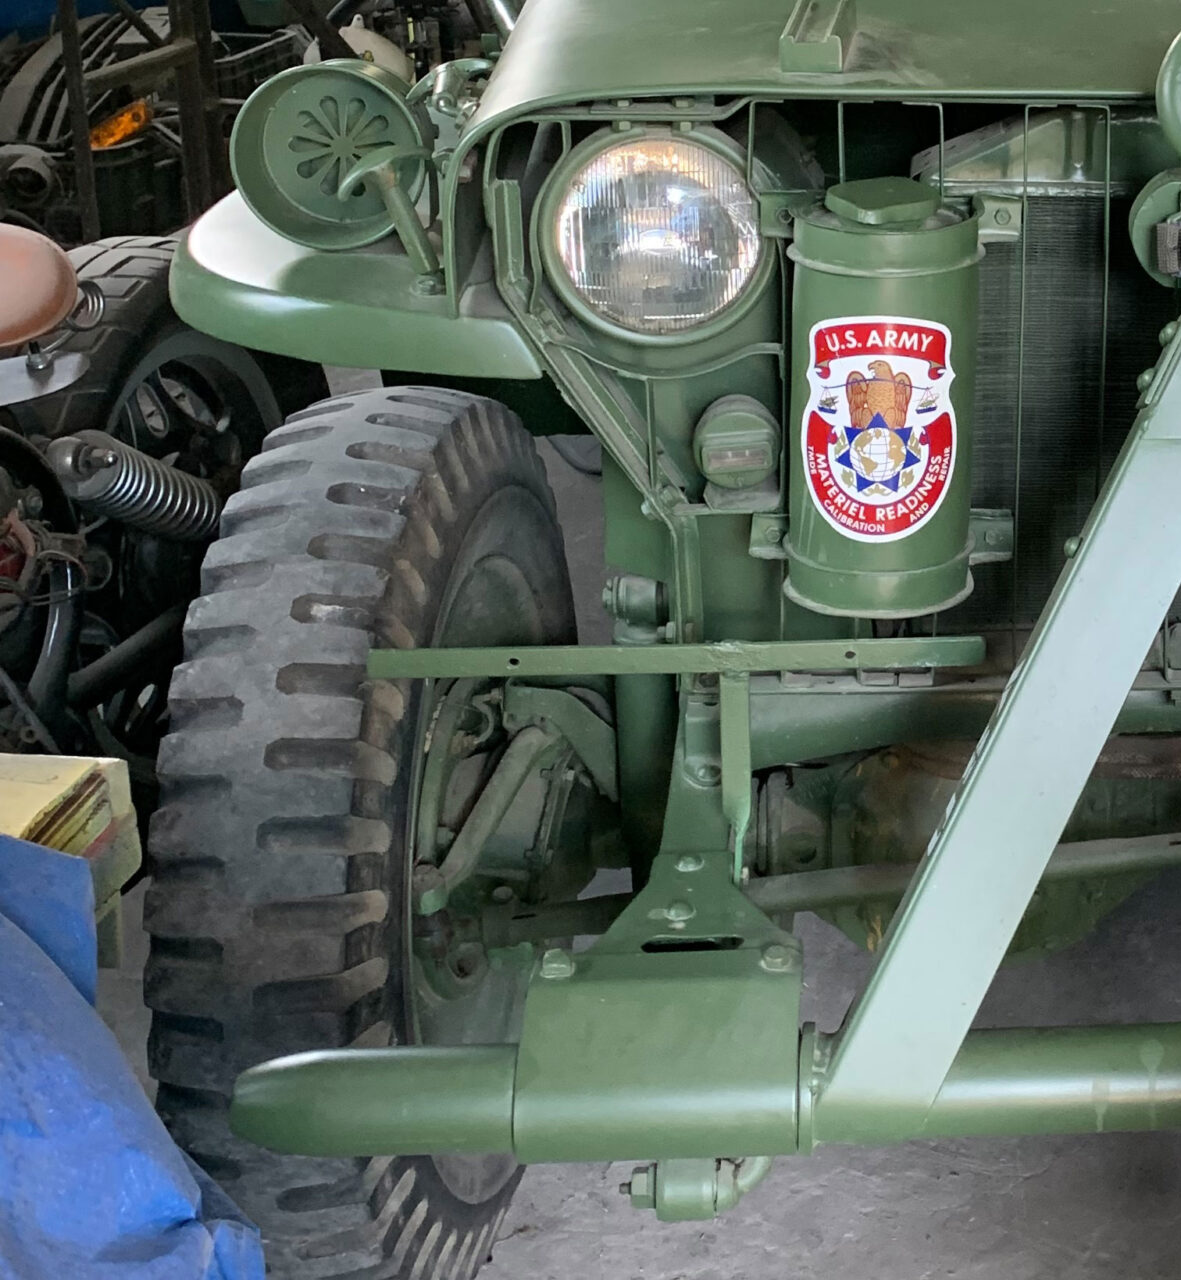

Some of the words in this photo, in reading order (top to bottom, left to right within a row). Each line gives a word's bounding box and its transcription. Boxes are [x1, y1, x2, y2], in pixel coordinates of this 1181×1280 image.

[824, 330, 863, 352] U.S.
[866, 329, 934, 353] ARMY
[808, 445, 817, 475] TMDE
[823, 499, 886, 533] CALIBRATION
[909, 503, 930, 523] AND
[939, 446, 952, 483] REPAIR
[815, 453, 867, 521] MATERIEL
[875, 454, 943, 522] READINESS
